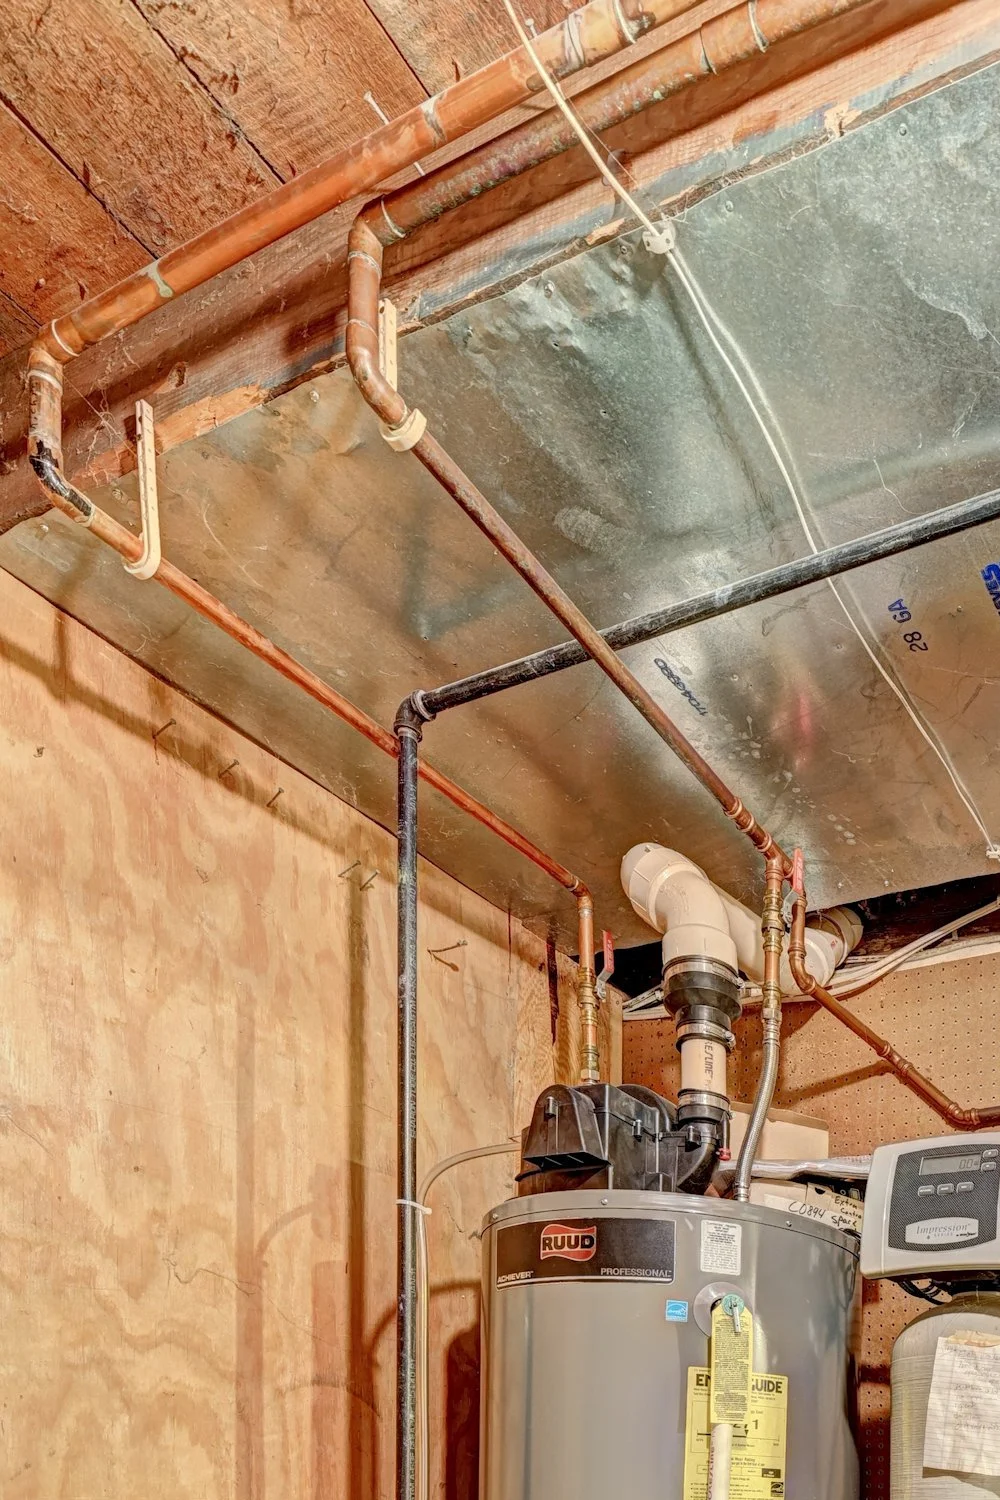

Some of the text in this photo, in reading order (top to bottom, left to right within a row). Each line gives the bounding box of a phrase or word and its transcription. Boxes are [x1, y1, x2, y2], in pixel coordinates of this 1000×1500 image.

[887, 598, 929, 653] 28 GA
[916, 1223, 967, 1235] Impression
[542, 1234, 595, 1251] RUUD
[497, 1267, 669, 1284] ACHIEVER PROFESSIONAL
